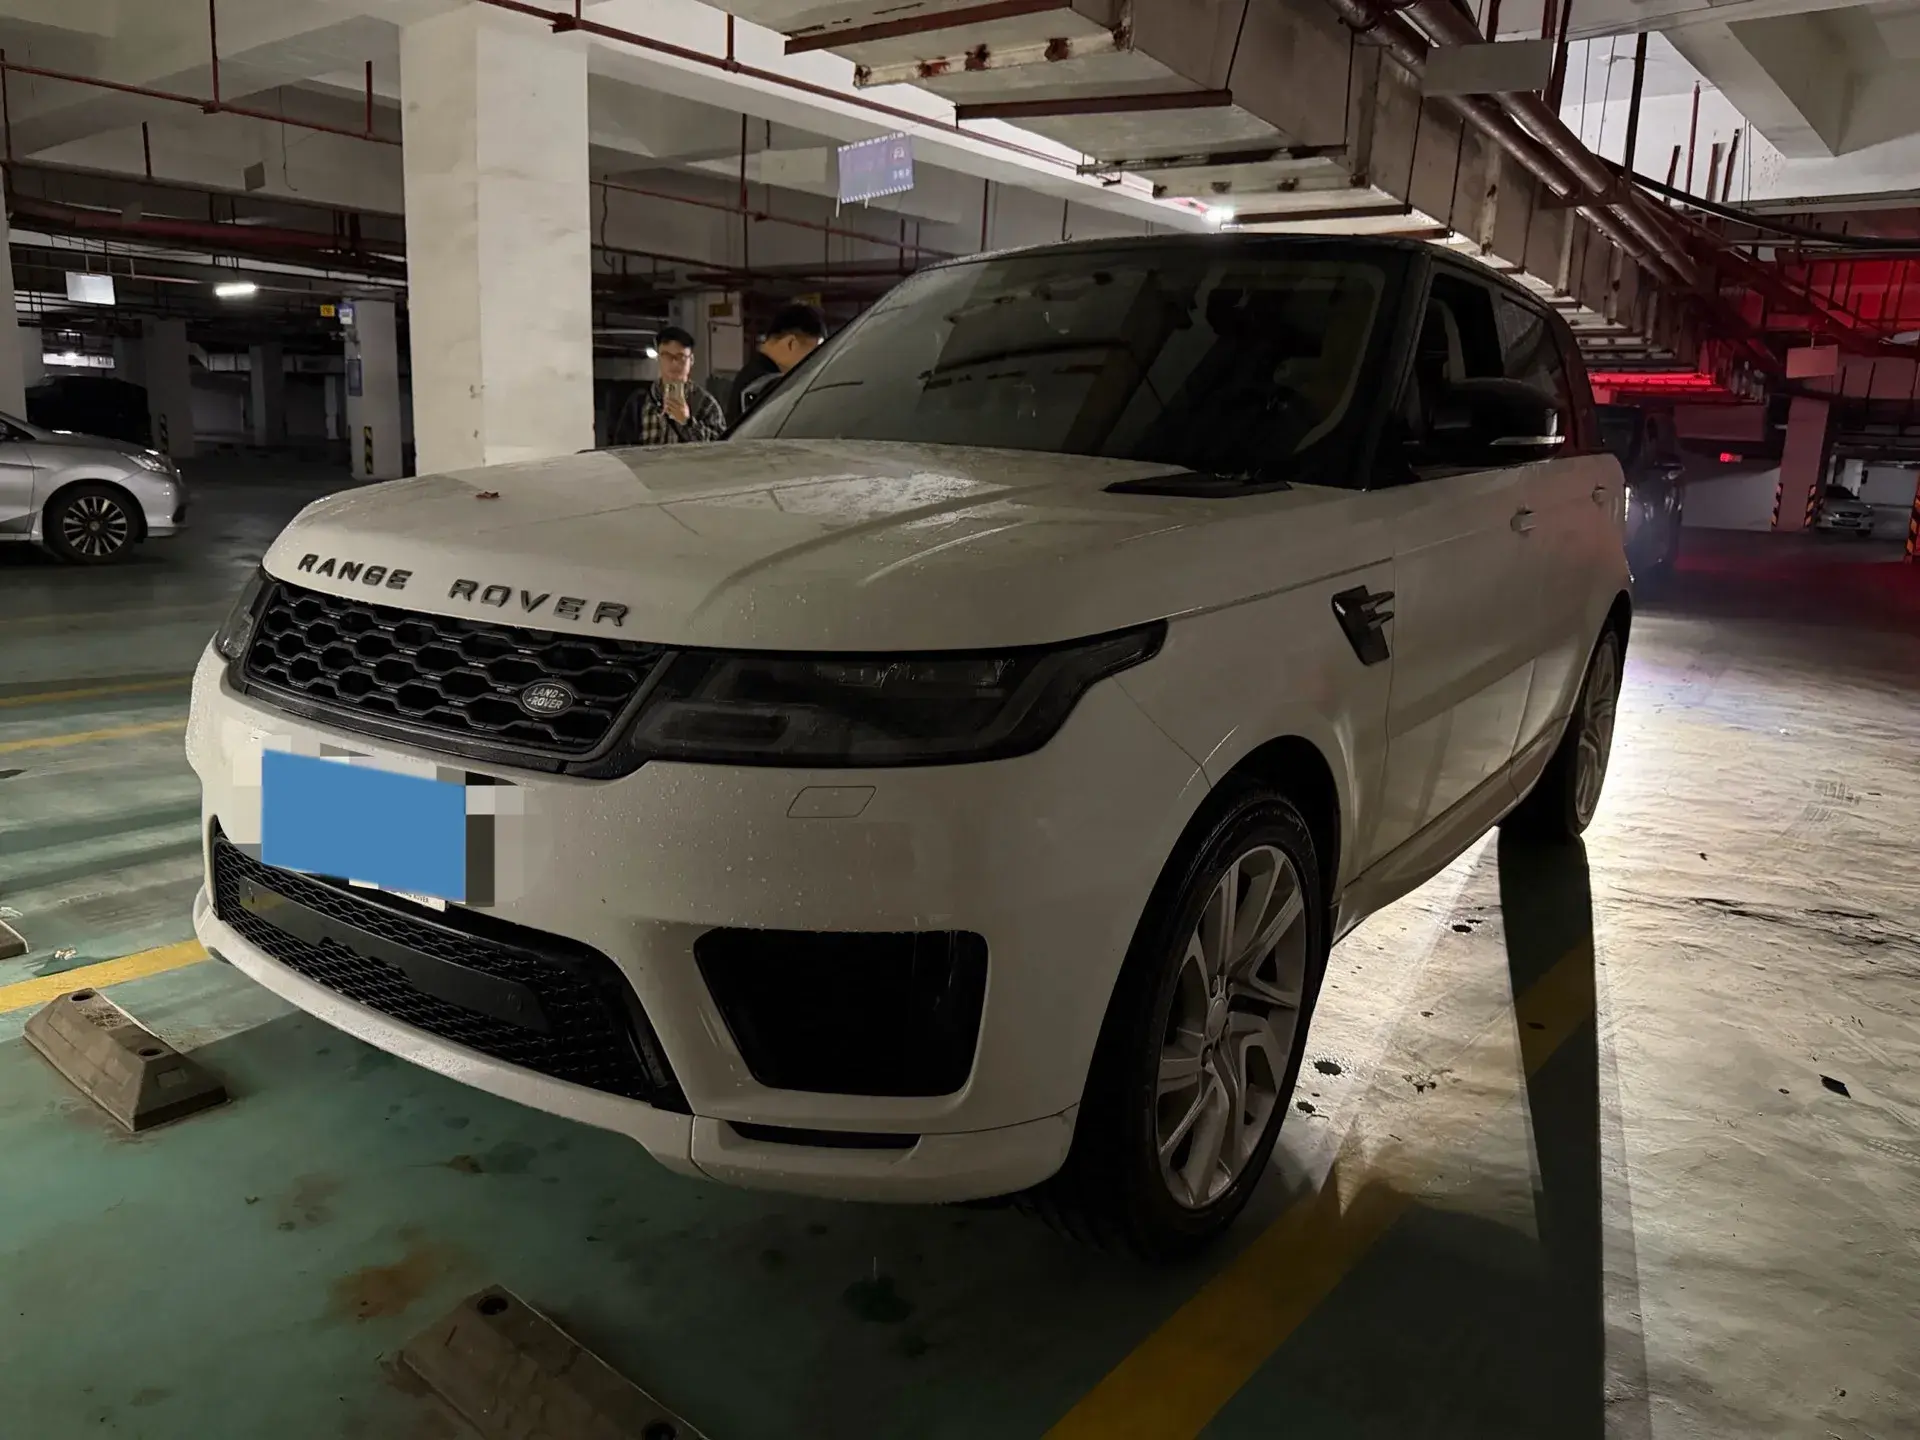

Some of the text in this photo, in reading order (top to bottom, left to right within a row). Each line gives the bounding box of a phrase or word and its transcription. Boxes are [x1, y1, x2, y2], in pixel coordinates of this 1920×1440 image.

[298, 553, 630, 627] RANGE ROVER
[532, 687, 559, 698] LAND
[531, 696, 564, 709] ROVER
